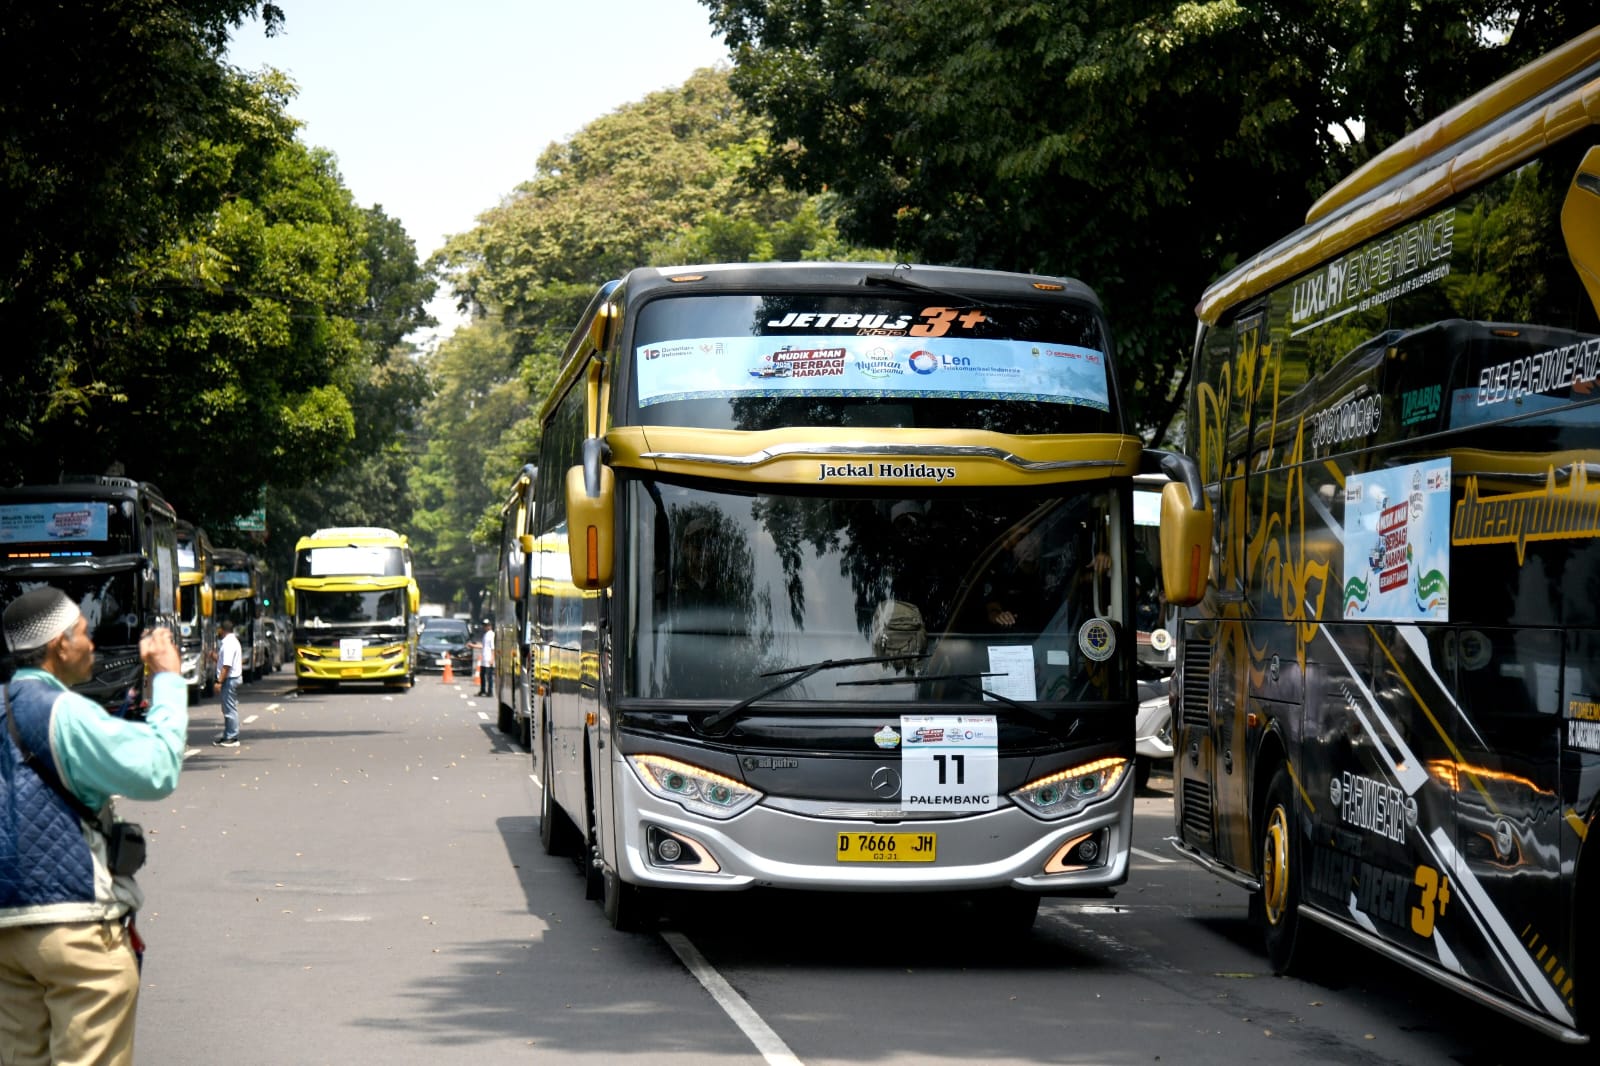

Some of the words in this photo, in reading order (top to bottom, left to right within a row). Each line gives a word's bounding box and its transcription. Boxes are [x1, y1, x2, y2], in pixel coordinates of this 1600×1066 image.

[1347, 207, 1456, 299] EXPERIENCE
[767, 313, 912, 329] JETBUS
[777, 351, 809, 361] MUDIK
[812, 349, 842, 359] AMAN
[942, 354, 971, 366] Len
[791, 368, 844, 378] HARAPAN
[792, 360, 845, 370] BERBAGI
[819, 463, 874, 481] Jackal
[879, 463, 956, 483] Holidays
[932, 754, 965, 785] 11
[910, 795, 991, 805] PALEMBANG
[1342, 770, 1406, 845] PARIWISATA
[839, 835, 849, 851] D
[858, 835, 896, 851] 7666
[914, 836, 933, 852] JH
